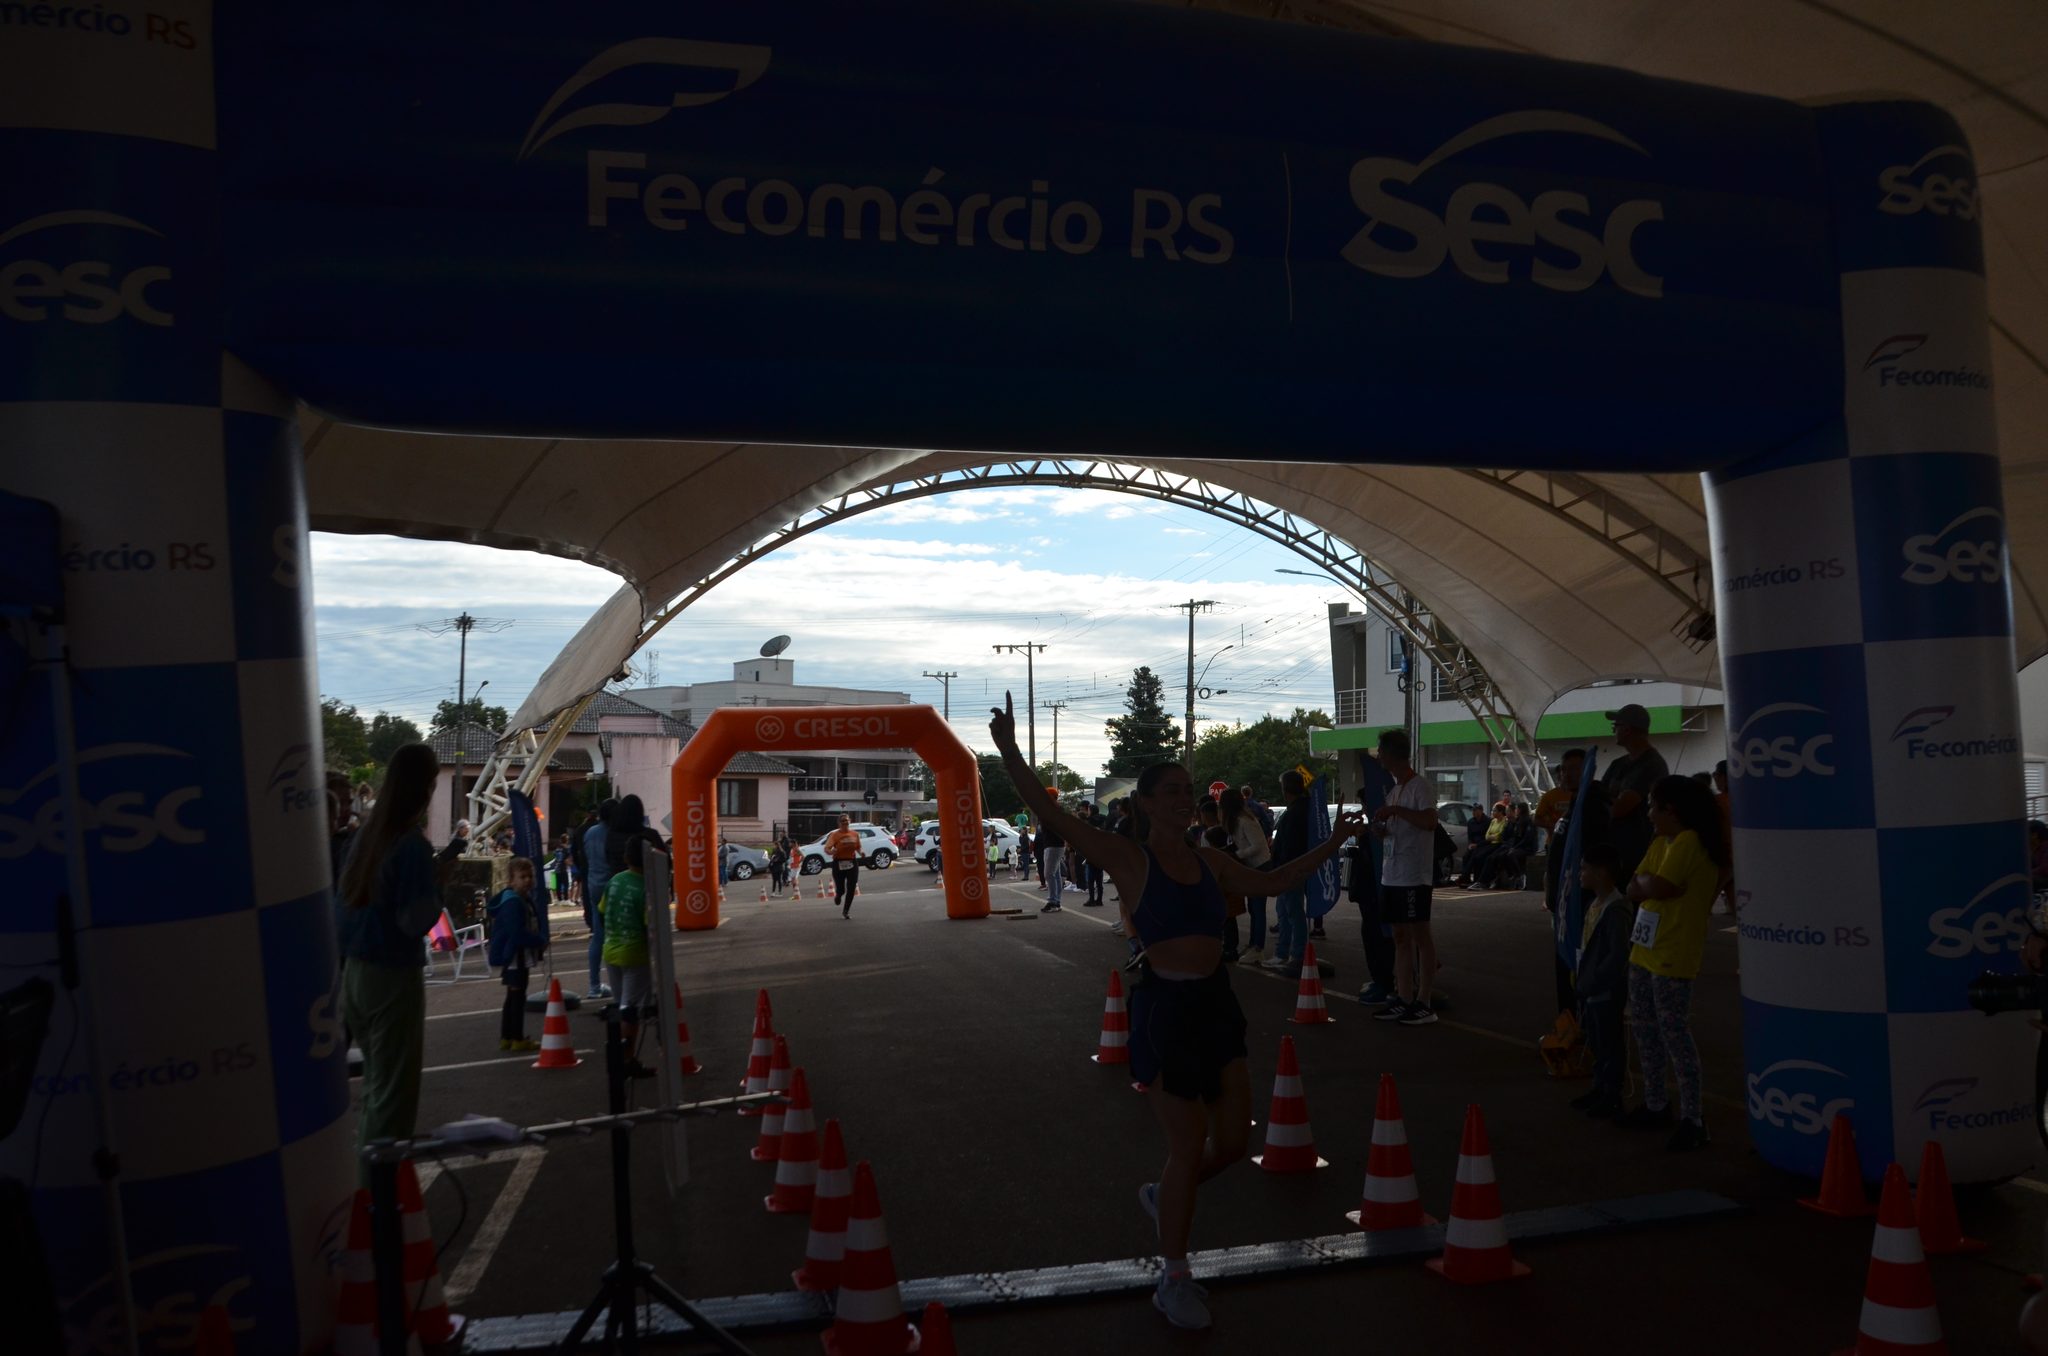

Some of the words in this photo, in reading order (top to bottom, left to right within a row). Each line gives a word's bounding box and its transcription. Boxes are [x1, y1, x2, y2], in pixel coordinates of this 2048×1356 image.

[145, 13, 196, 50] RS
[586, 149, 1102, 256] Fecomércio
[1130, 188, 1235, 265] RS
[1340, 156, 1665, 299] Sesc
[0, 258, 175, 328] esc
[167, 542, 216, 571] RS
[1808, 557, 1846, 581] RS
[793, 716, 899, 739] CRESOL
[687, 793, 707, 883] CRESOL
[957, 782, 980, 870] CRESOL
[1833, 926, 1871, 947] RS
[210, 1043, 257, 1077] RS
